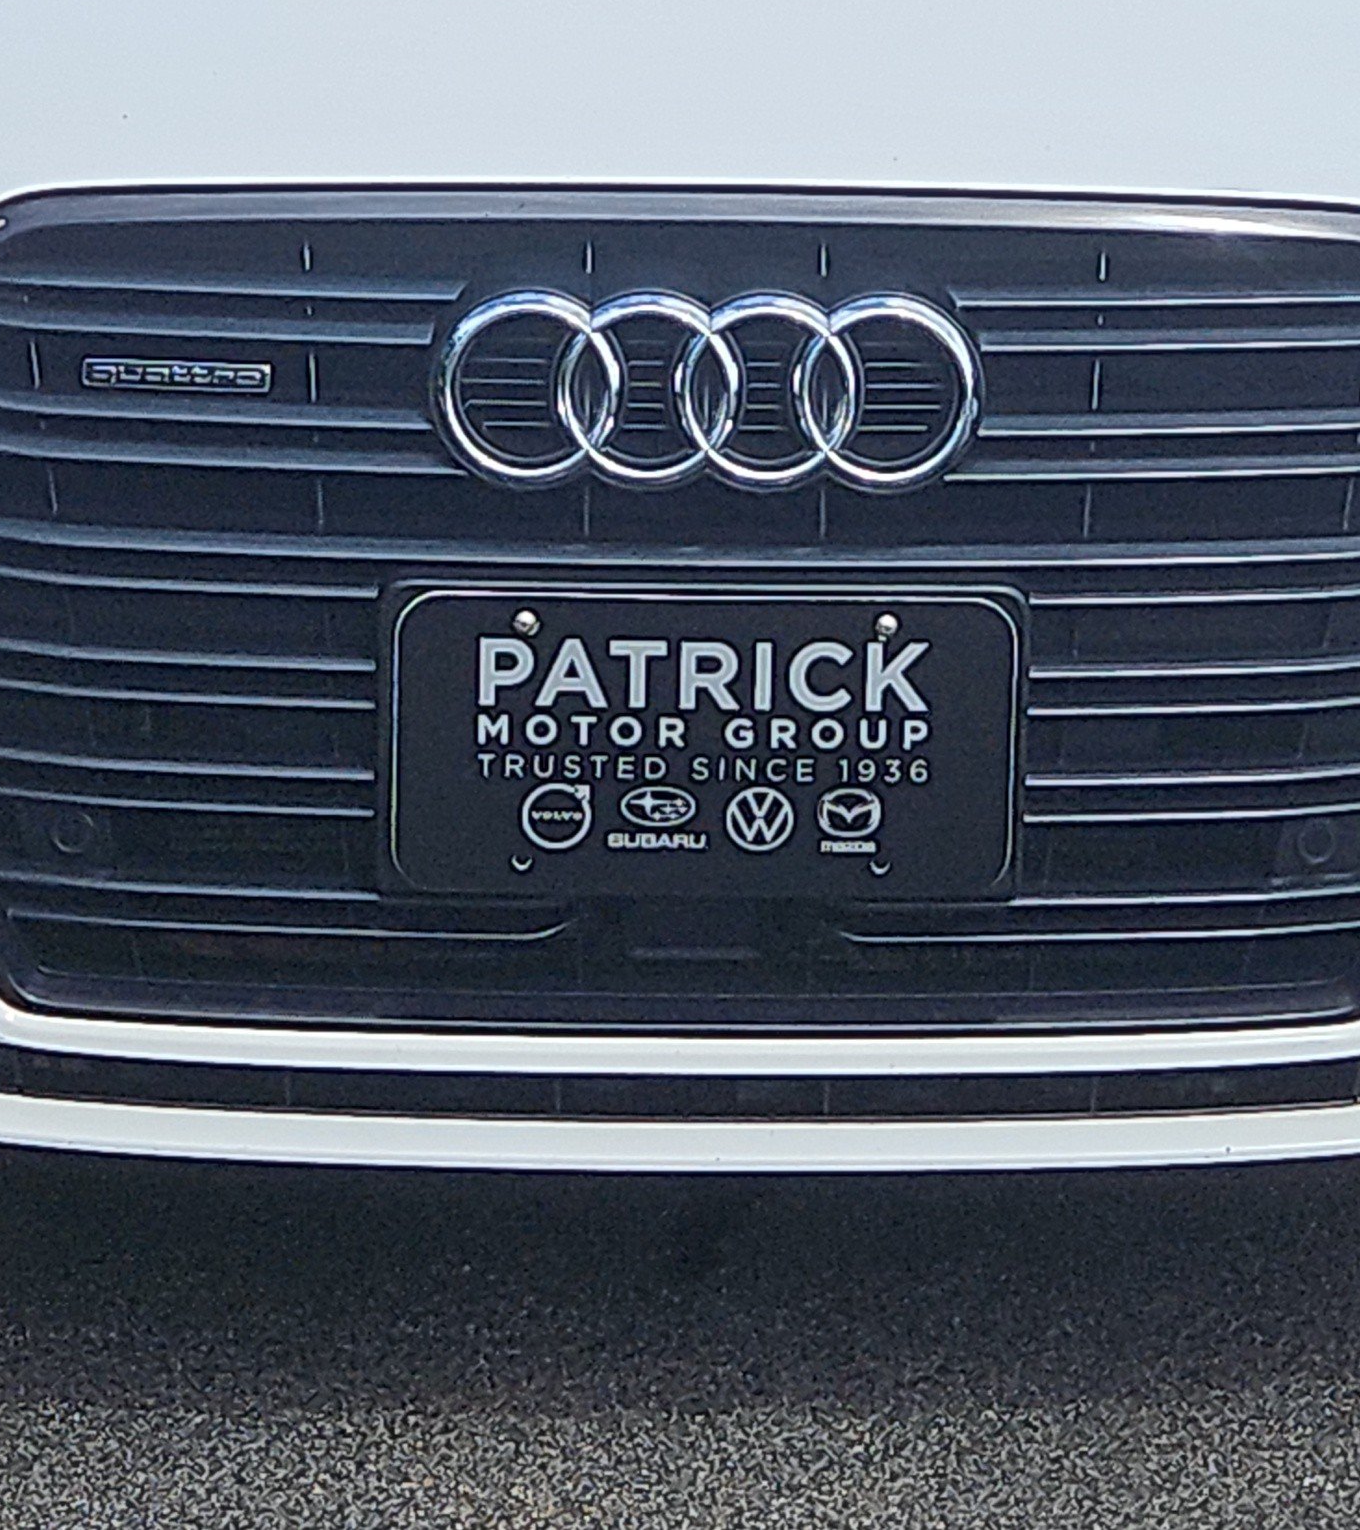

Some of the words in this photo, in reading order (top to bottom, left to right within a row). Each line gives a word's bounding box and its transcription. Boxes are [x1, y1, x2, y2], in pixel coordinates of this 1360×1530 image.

[91, 364, 263, 386] quattro
[476, 636, 930, 712] PATRICK
[477, 714, 687, 749] MOTOR
[724, 717, 929, 751] GROUP
[477, 754, 667, 780] TRUSTED
[692, 757, 815, 783] SINCE
[838, 758, 929, 783] 1936
[531, 810, 584, 821] VOLVO
[606, 832, 708, 849] SUBARU
